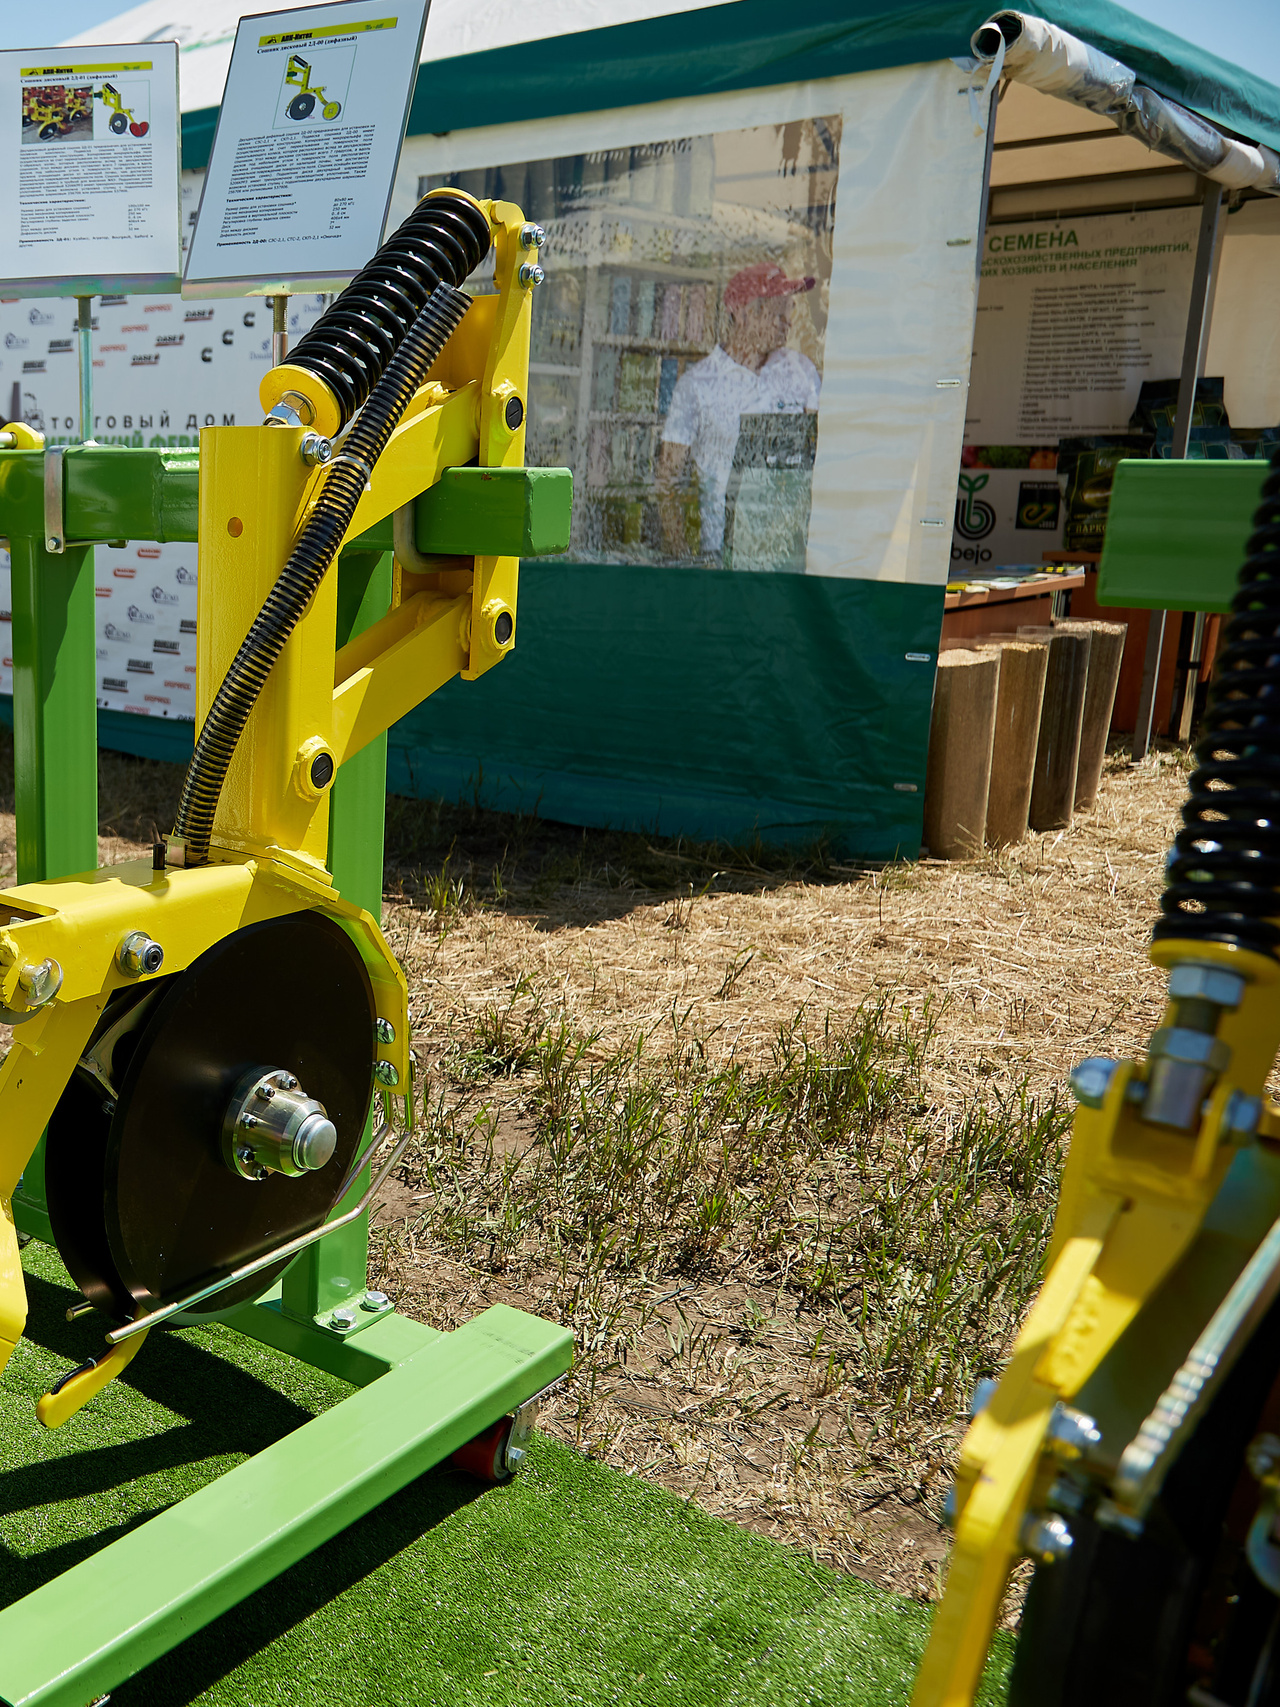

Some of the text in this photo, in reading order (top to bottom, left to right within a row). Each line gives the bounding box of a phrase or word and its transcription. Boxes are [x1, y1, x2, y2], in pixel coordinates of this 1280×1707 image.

[988, 230, 1079, 252] СЕМЕНА
[1104, 241, 1193, 257] ПРЕДПРИЯТИЙ,
[1001, 263, 1057, 277] ХОЗЯЙСТВ
[1059, 262, 1068, 273] И
[1069, 258, 1138, 272] НАСЕЛЕНИЯ
[51, 411, 170, 431] тоговый
[951, 543, 993, 565] bejo
